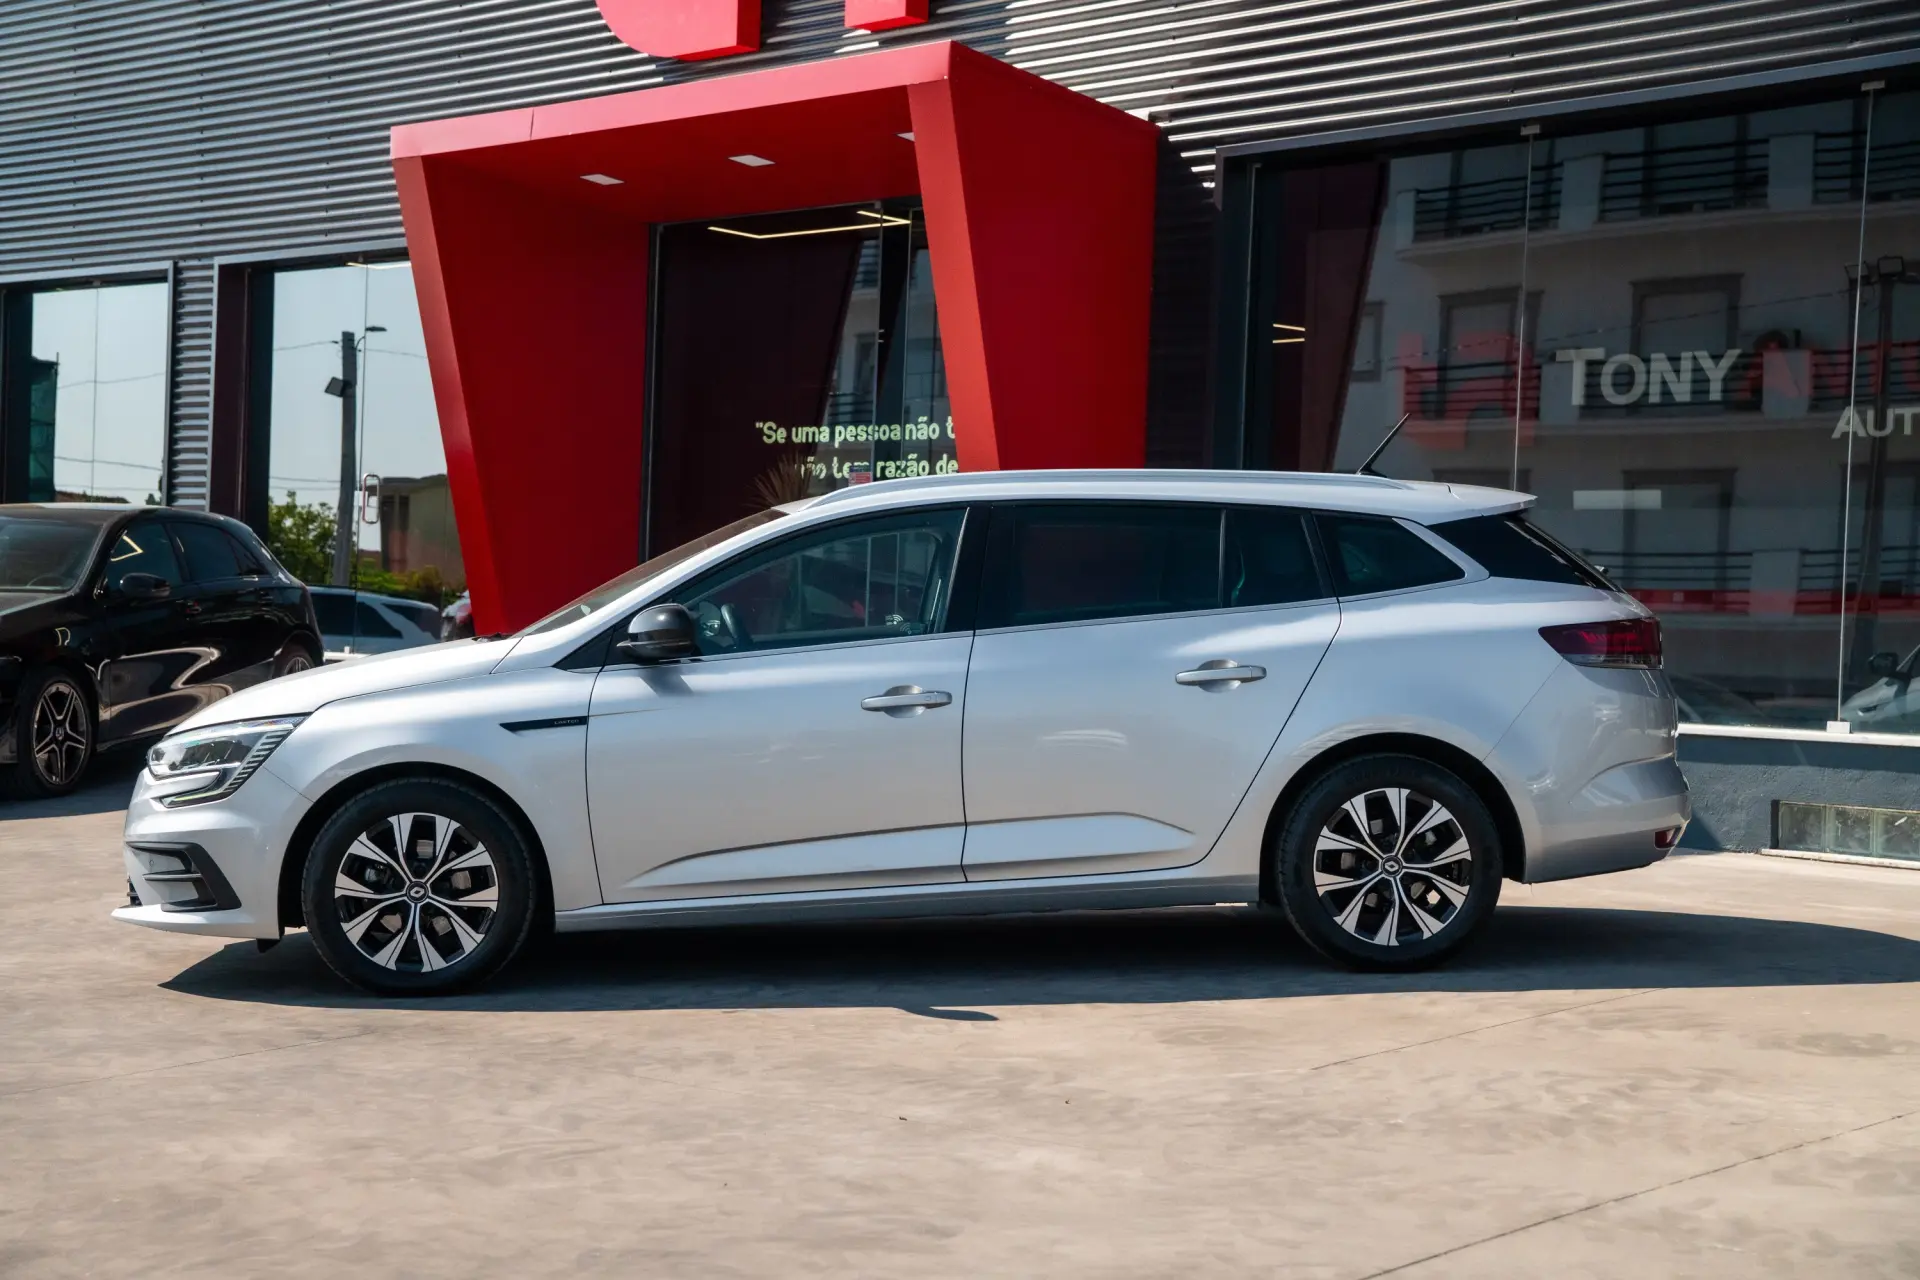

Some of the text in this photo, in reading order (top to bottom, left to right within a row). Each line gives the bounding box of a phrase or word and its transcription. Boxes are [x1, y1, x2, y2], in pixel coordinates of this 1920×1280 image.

[1555, 348, 1743, 406] TONY
[755, 421, 787, 444] "Se
[792, 425, 830, 444] uma
[834, 424, 901, 448] pessoa
[905, 416, 940, 440] não
[1831, 403, 1920, 439] AUT
[832, 456, 870, 479] te
[876, 453, 929, 478] razão
